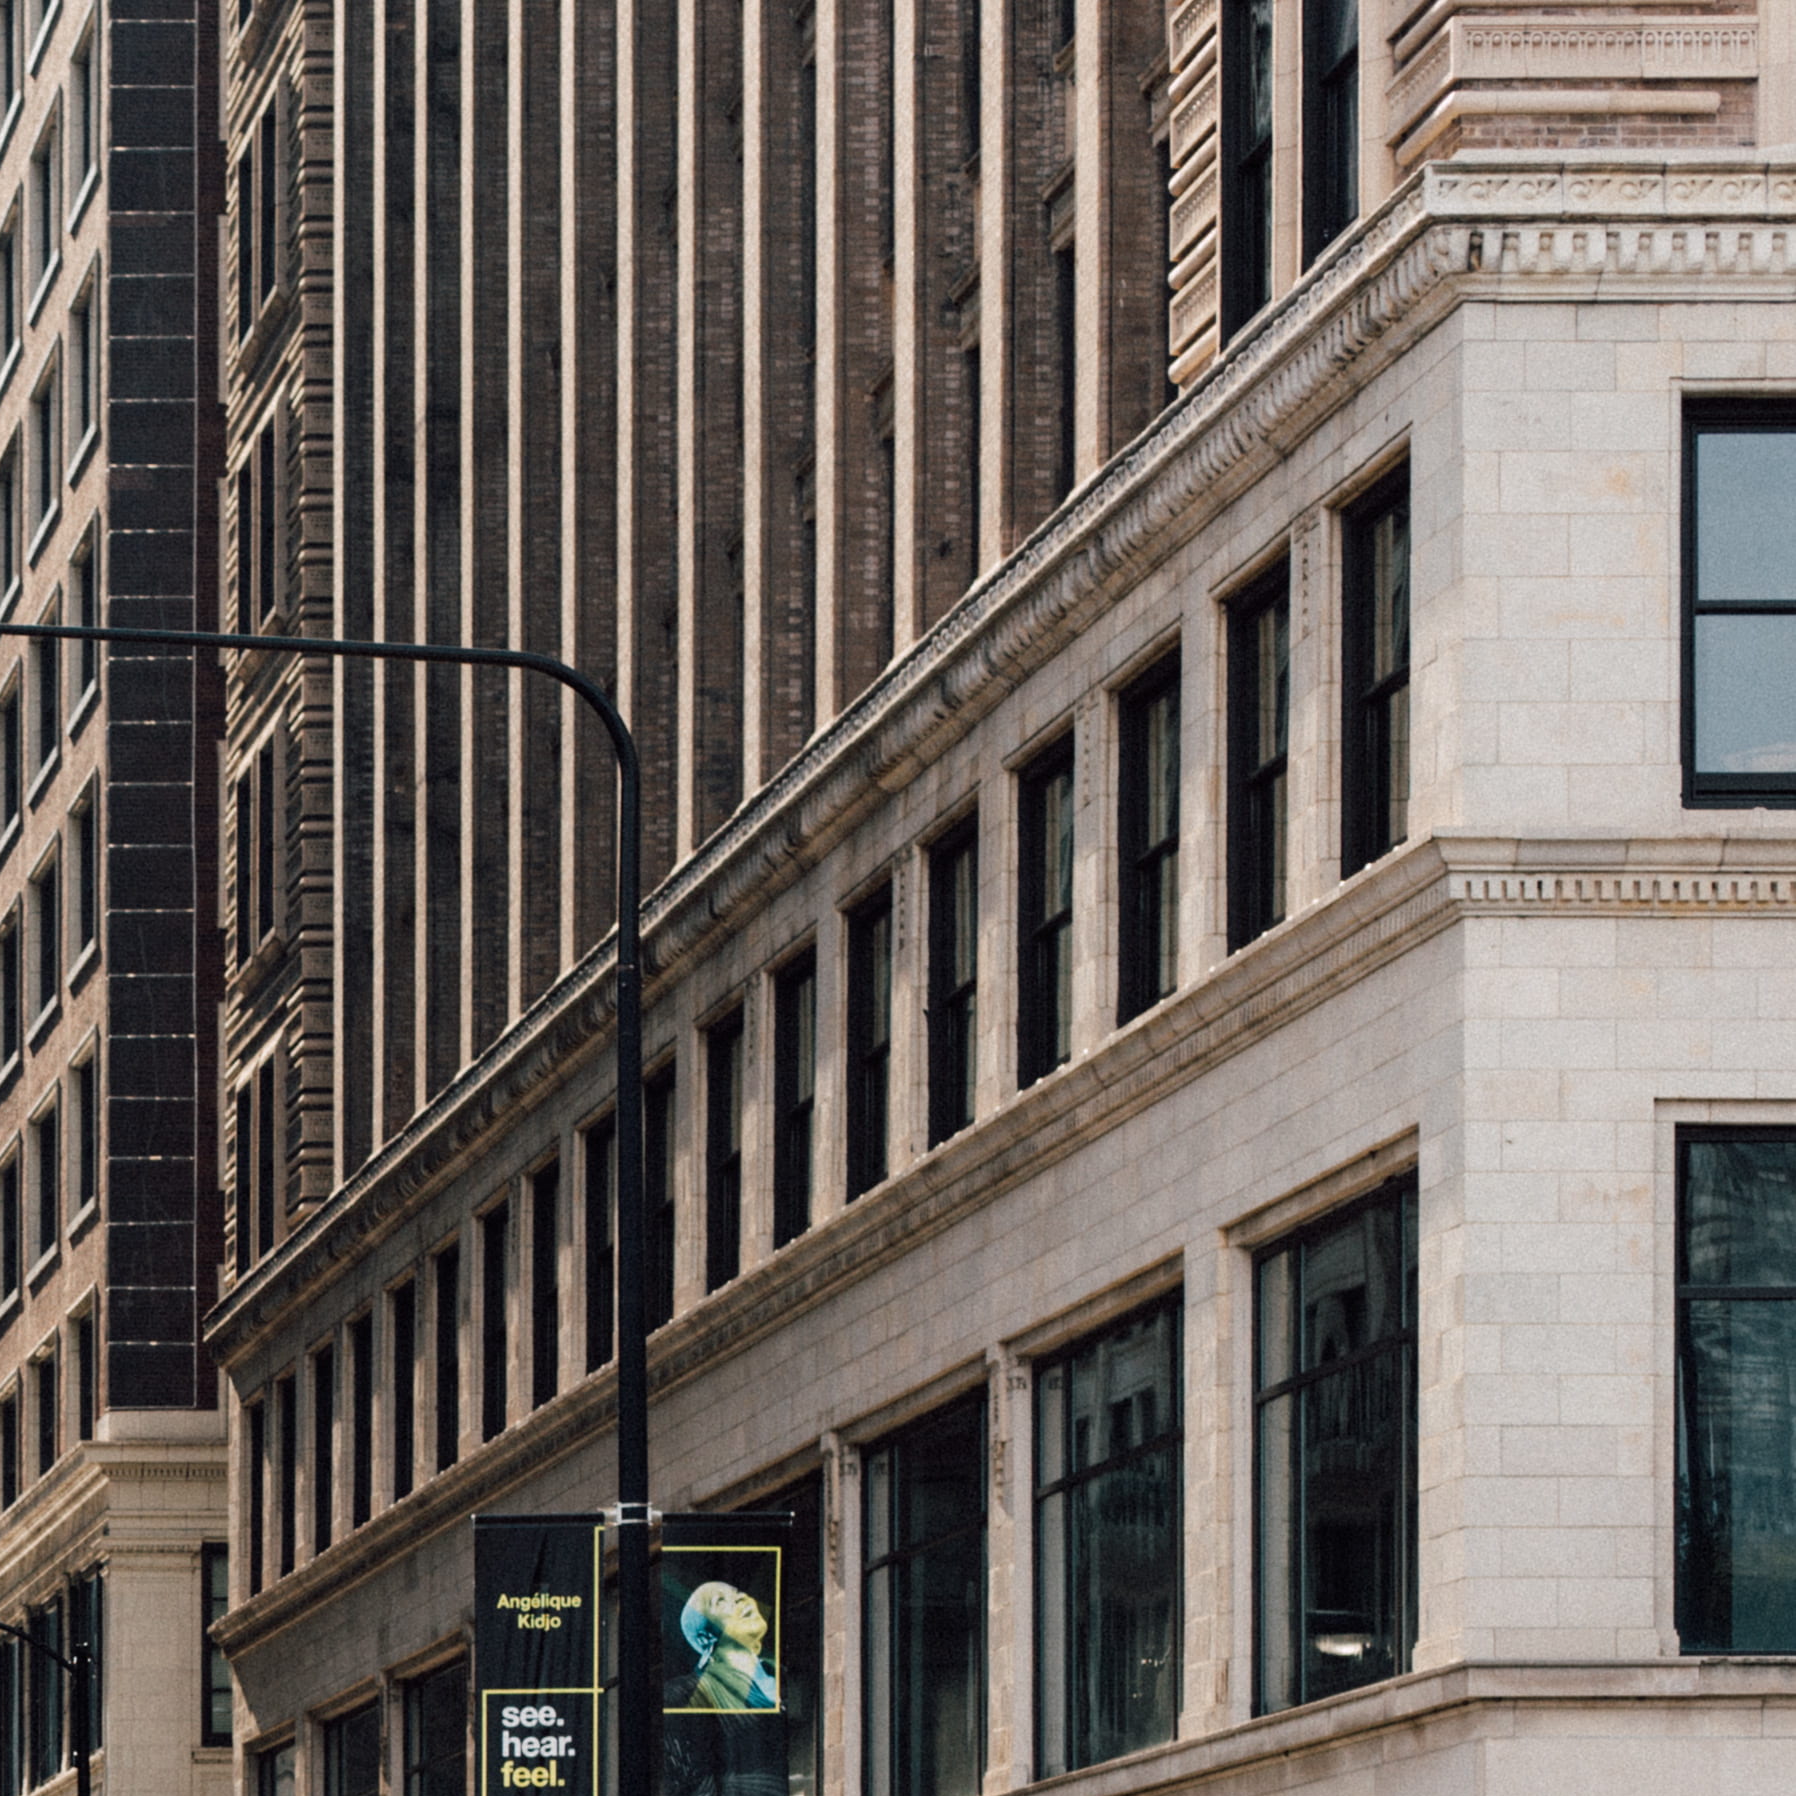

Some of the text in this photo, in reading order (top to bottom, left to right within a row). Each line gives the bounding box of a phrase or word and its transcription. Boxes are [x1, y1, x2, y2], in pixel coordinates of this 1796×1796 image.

[497, 1592, 582, 1613] Angélique
[517, 1614, 562, 1631] Kidjo
[501, 1704, 564, 1728] see.
[501, 1732, 575, 1758] hear.
[501, 1761, 565, 1788] feel.
